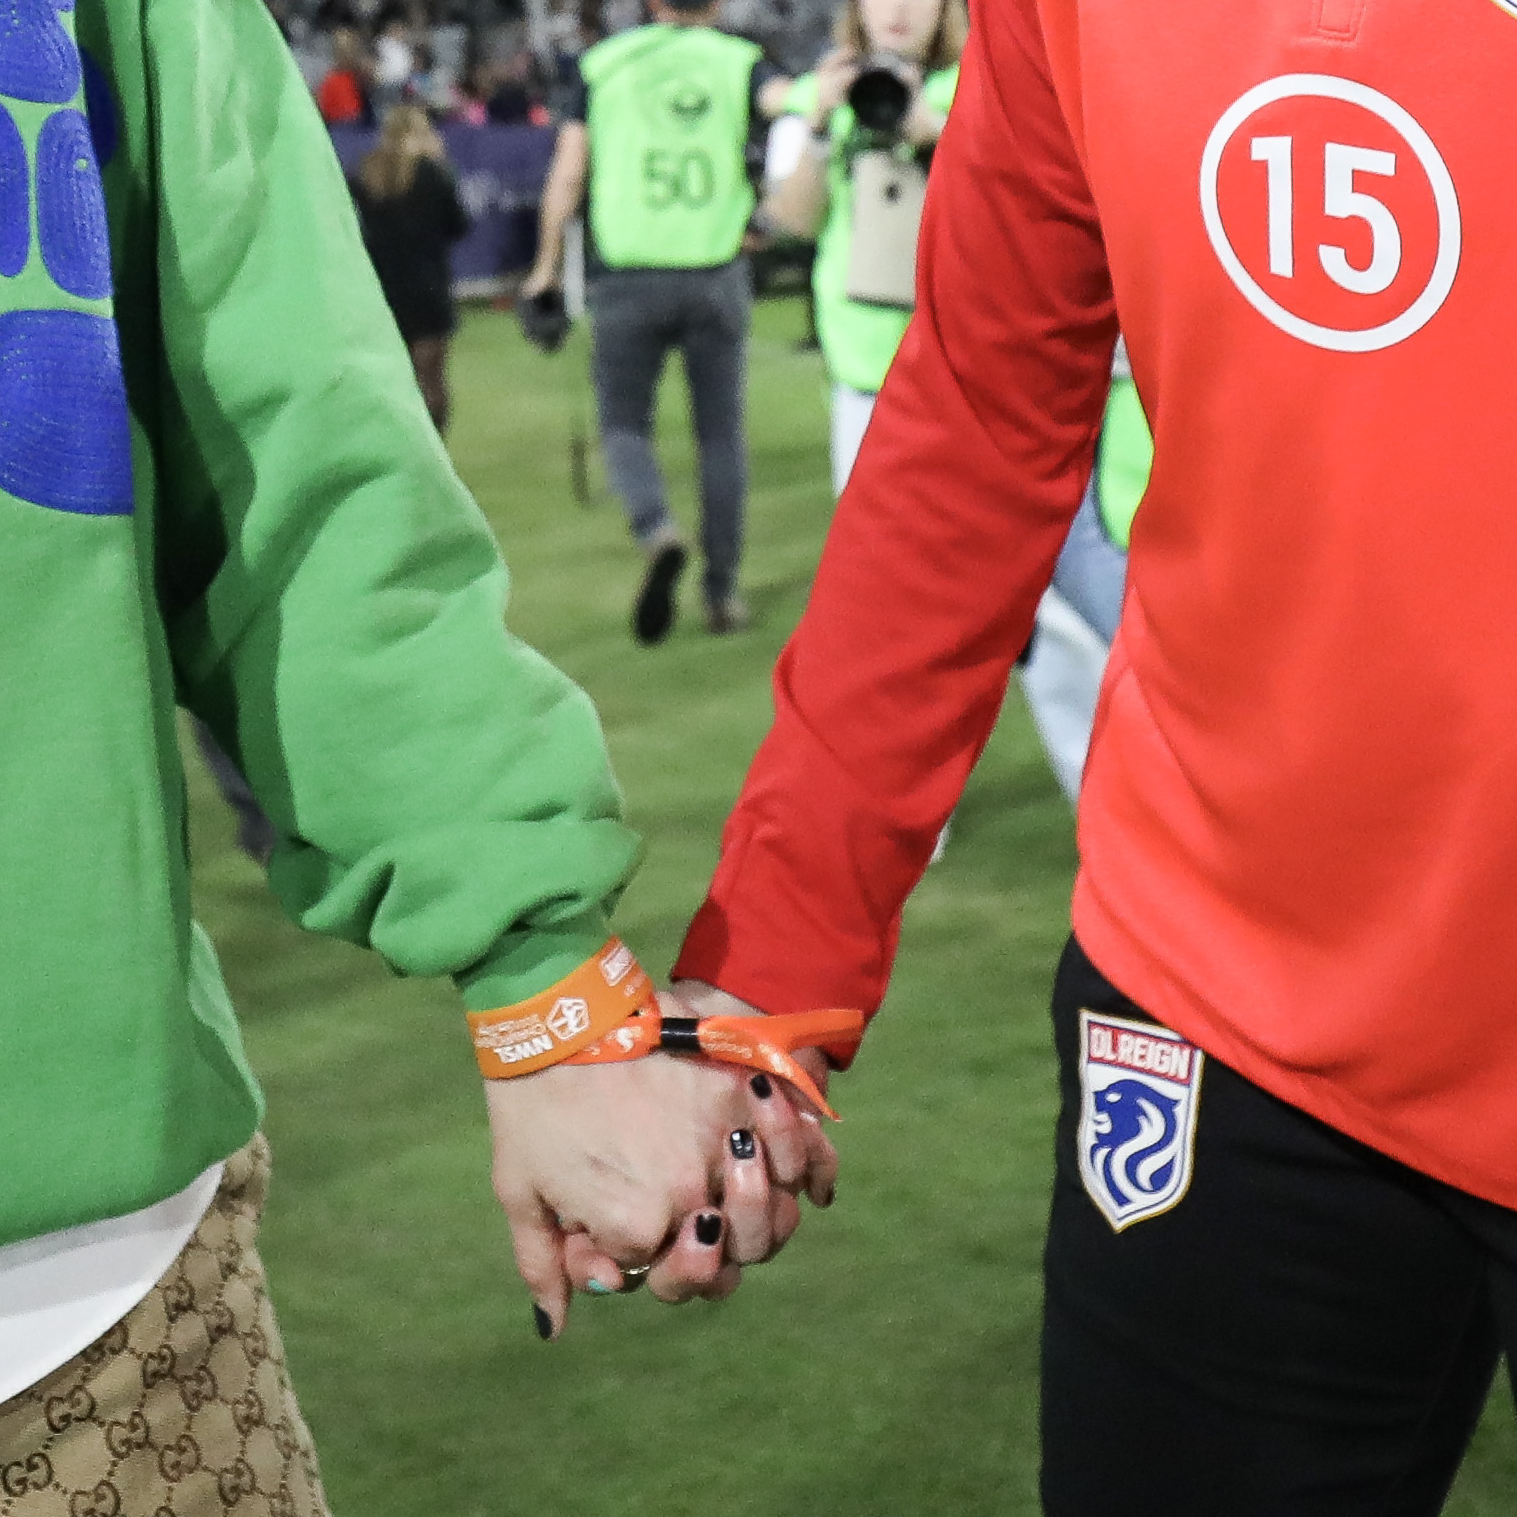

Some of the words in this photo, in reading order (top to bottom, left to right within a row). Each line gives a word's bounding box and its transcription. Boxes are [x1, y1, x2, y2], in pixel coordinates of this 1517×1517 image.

[642, 146, 715, 210] 50
[1249, 135, 1403, 296] 15
[1089, 1027, 1118, 1061] OL
[1118, 1032, 1192, 1080] REIGN
